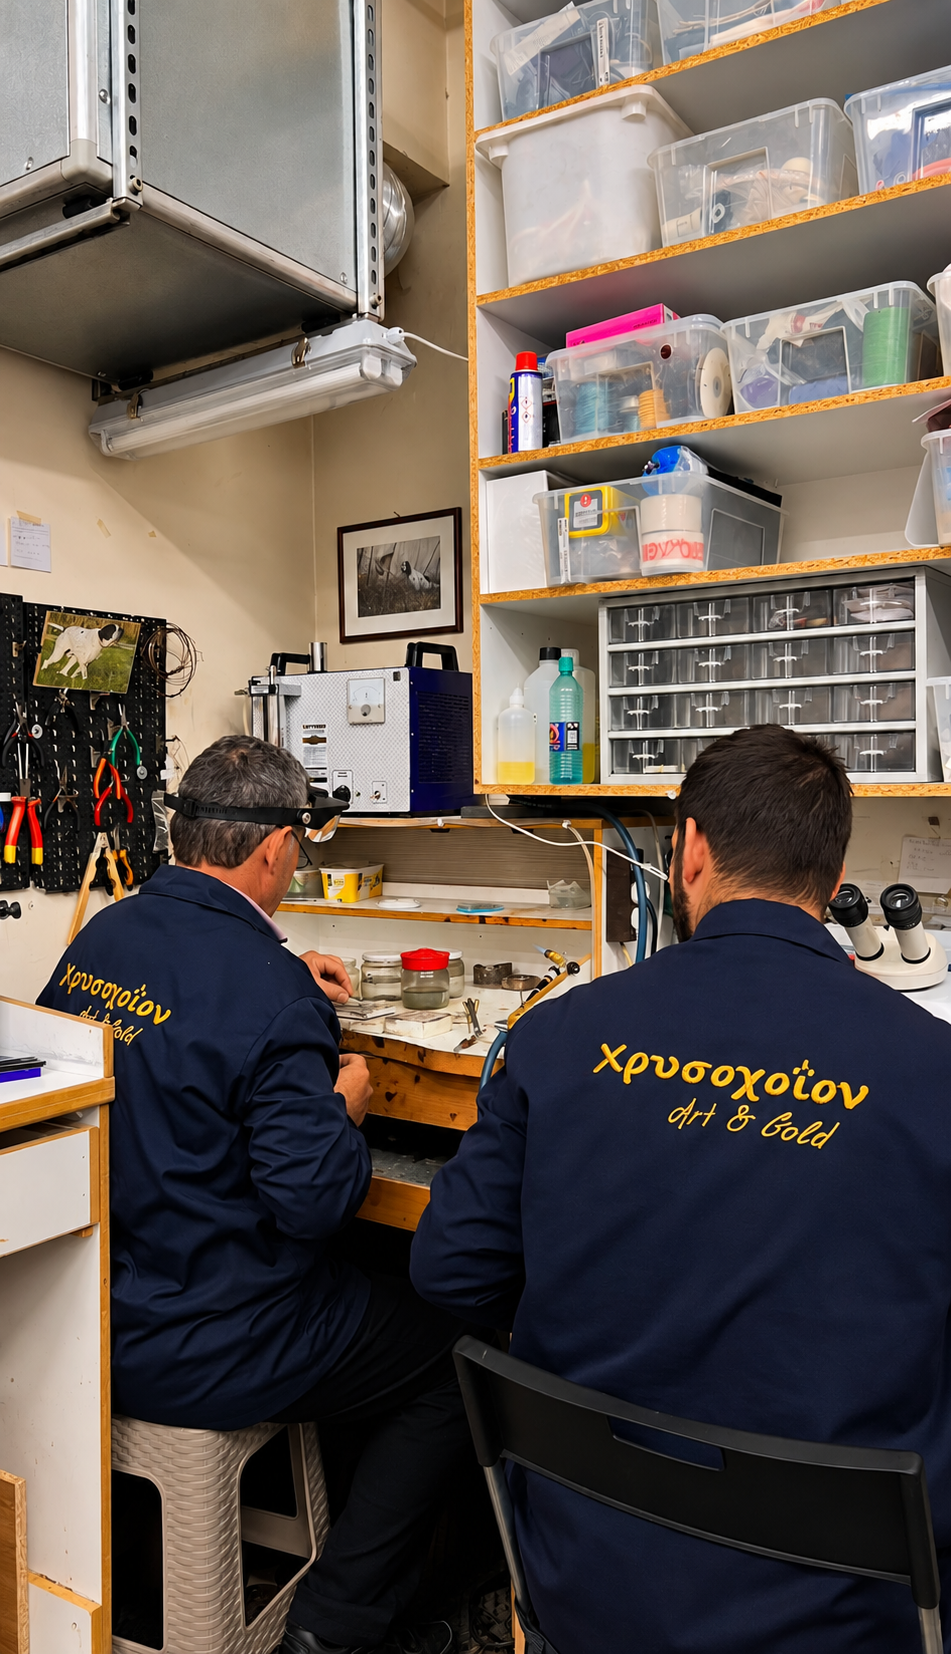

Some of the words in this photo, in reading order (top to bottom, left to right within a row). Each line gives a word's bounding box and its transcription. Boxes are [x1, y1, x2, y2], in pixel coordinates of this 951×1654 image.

[667, 1098, 717, 1130] Art
[726, 1104, 756, 1132] &
[761, 1111, 840, 1149] Gold
